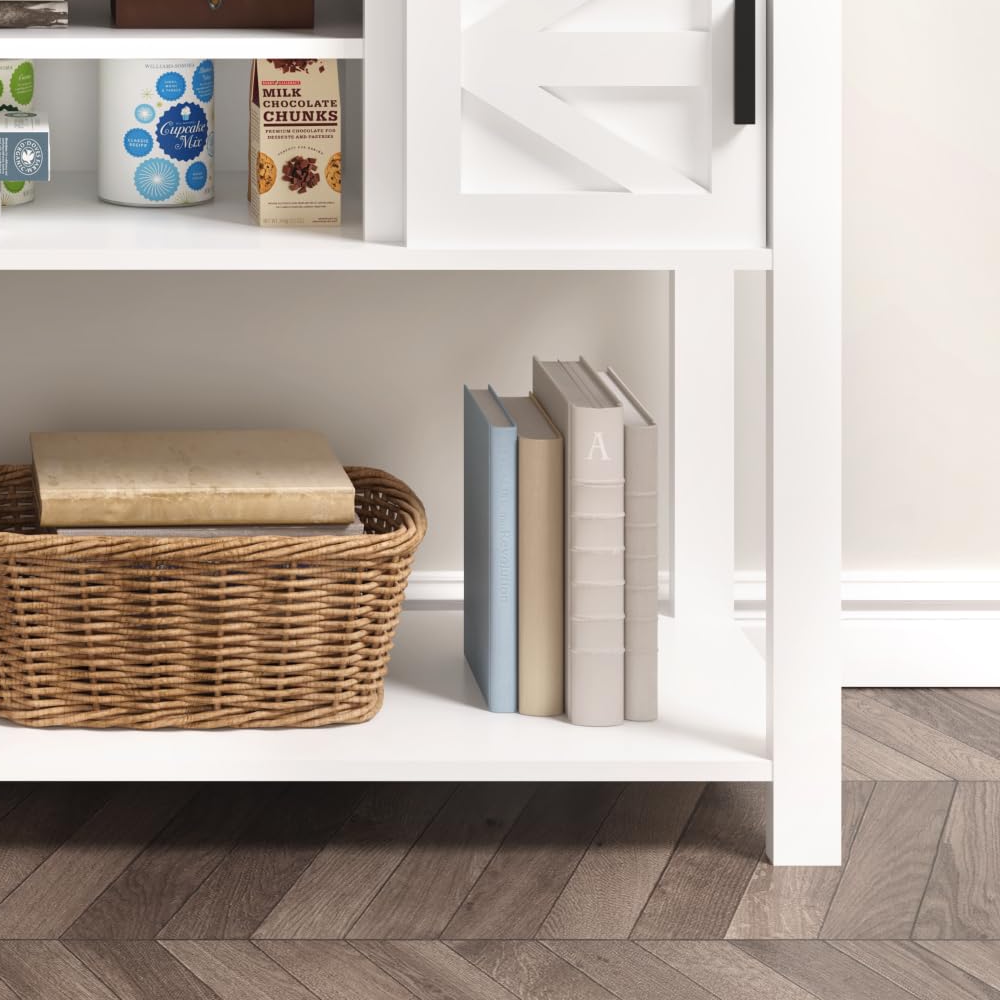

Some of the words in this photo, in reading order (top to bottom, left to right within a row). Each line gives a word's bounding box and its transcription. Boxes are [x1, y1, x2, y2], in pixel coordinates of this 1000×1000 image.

[262, 88, 302, 98] MILK
[262, 99, 338, 108] CHOCOLATE
[263, 110, 338, 122] CHUNKS
[159, 120, 206, 138] Cupcake
[174, 134, 203, 149] Mix
[584, 431, 612, 461] A
